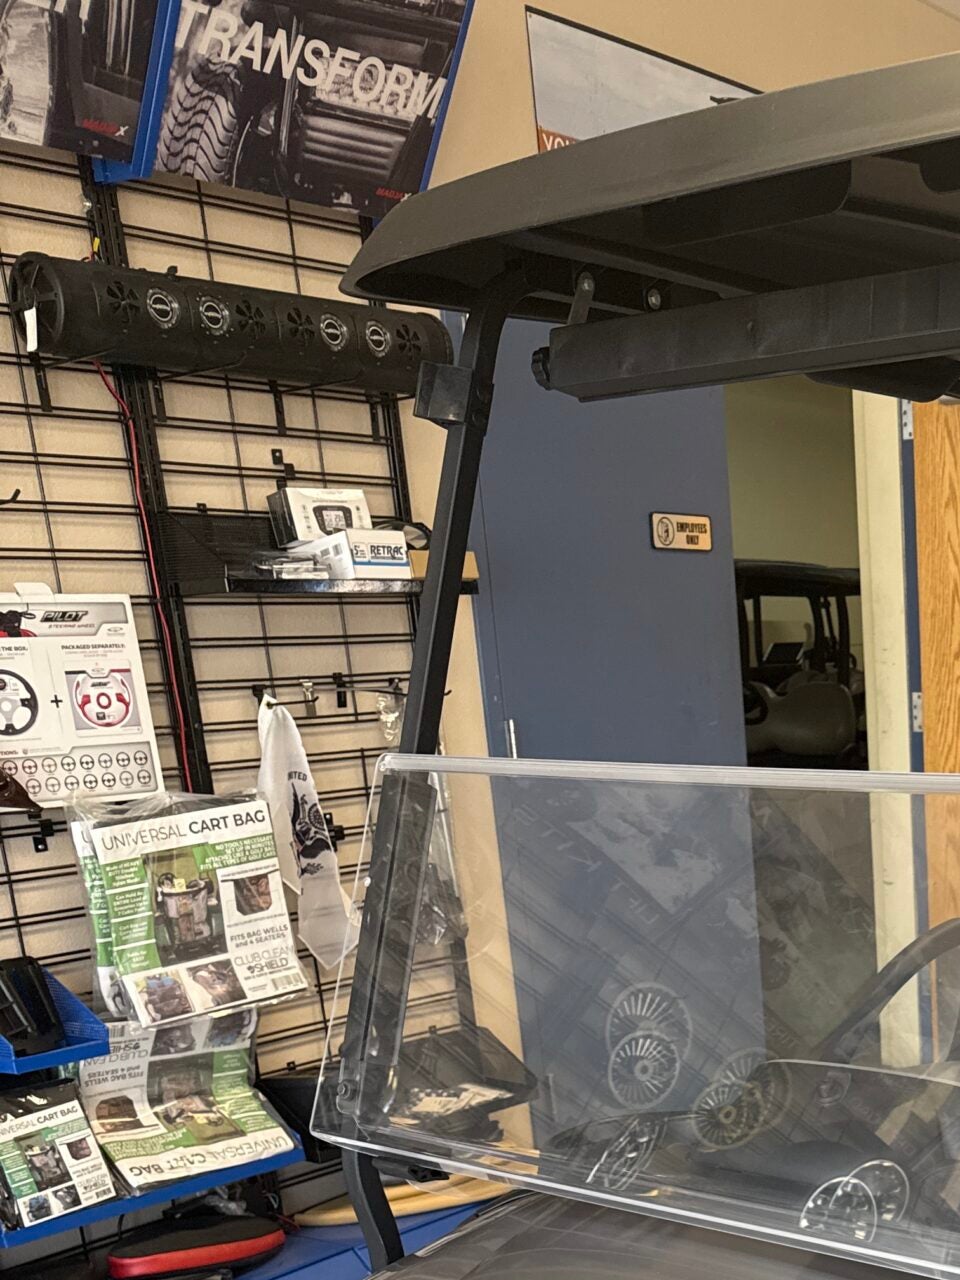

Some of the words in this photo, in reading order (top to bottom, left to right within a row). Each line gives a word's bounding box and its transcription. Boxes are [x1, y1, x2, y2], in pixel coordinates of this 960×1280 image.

[173, 1, 449, 120] TRANSFORM
[676, 521, 708, 534] EMPLOYEES
[686, 534, 699, 545] ONLY
[42, 610, 87, 622] PILOT
[101, 824, 187, 851] UNIVERSAL
[188, 815, 231, 835] CART
[233, 809, 266, 828] BAG
[230, 933, 246, 943] FITS
[246, 929, 261, 939] BAG
[263, 923, 289, 935] WELLS
[255, 933, 286, 945] SEATERS
[254, 957, 289, 973] SHIELD
[84, 1075, 109, 1087] WELLS
[110, 1072, 128, 1083] BAG
[36, 1111, 60, 1124] CART
[60, 1105, 78, 1117] BAG
[213, 1135, 289, 1160] UNIVERSAL
[129, 1162, 165, 1177] BAG
